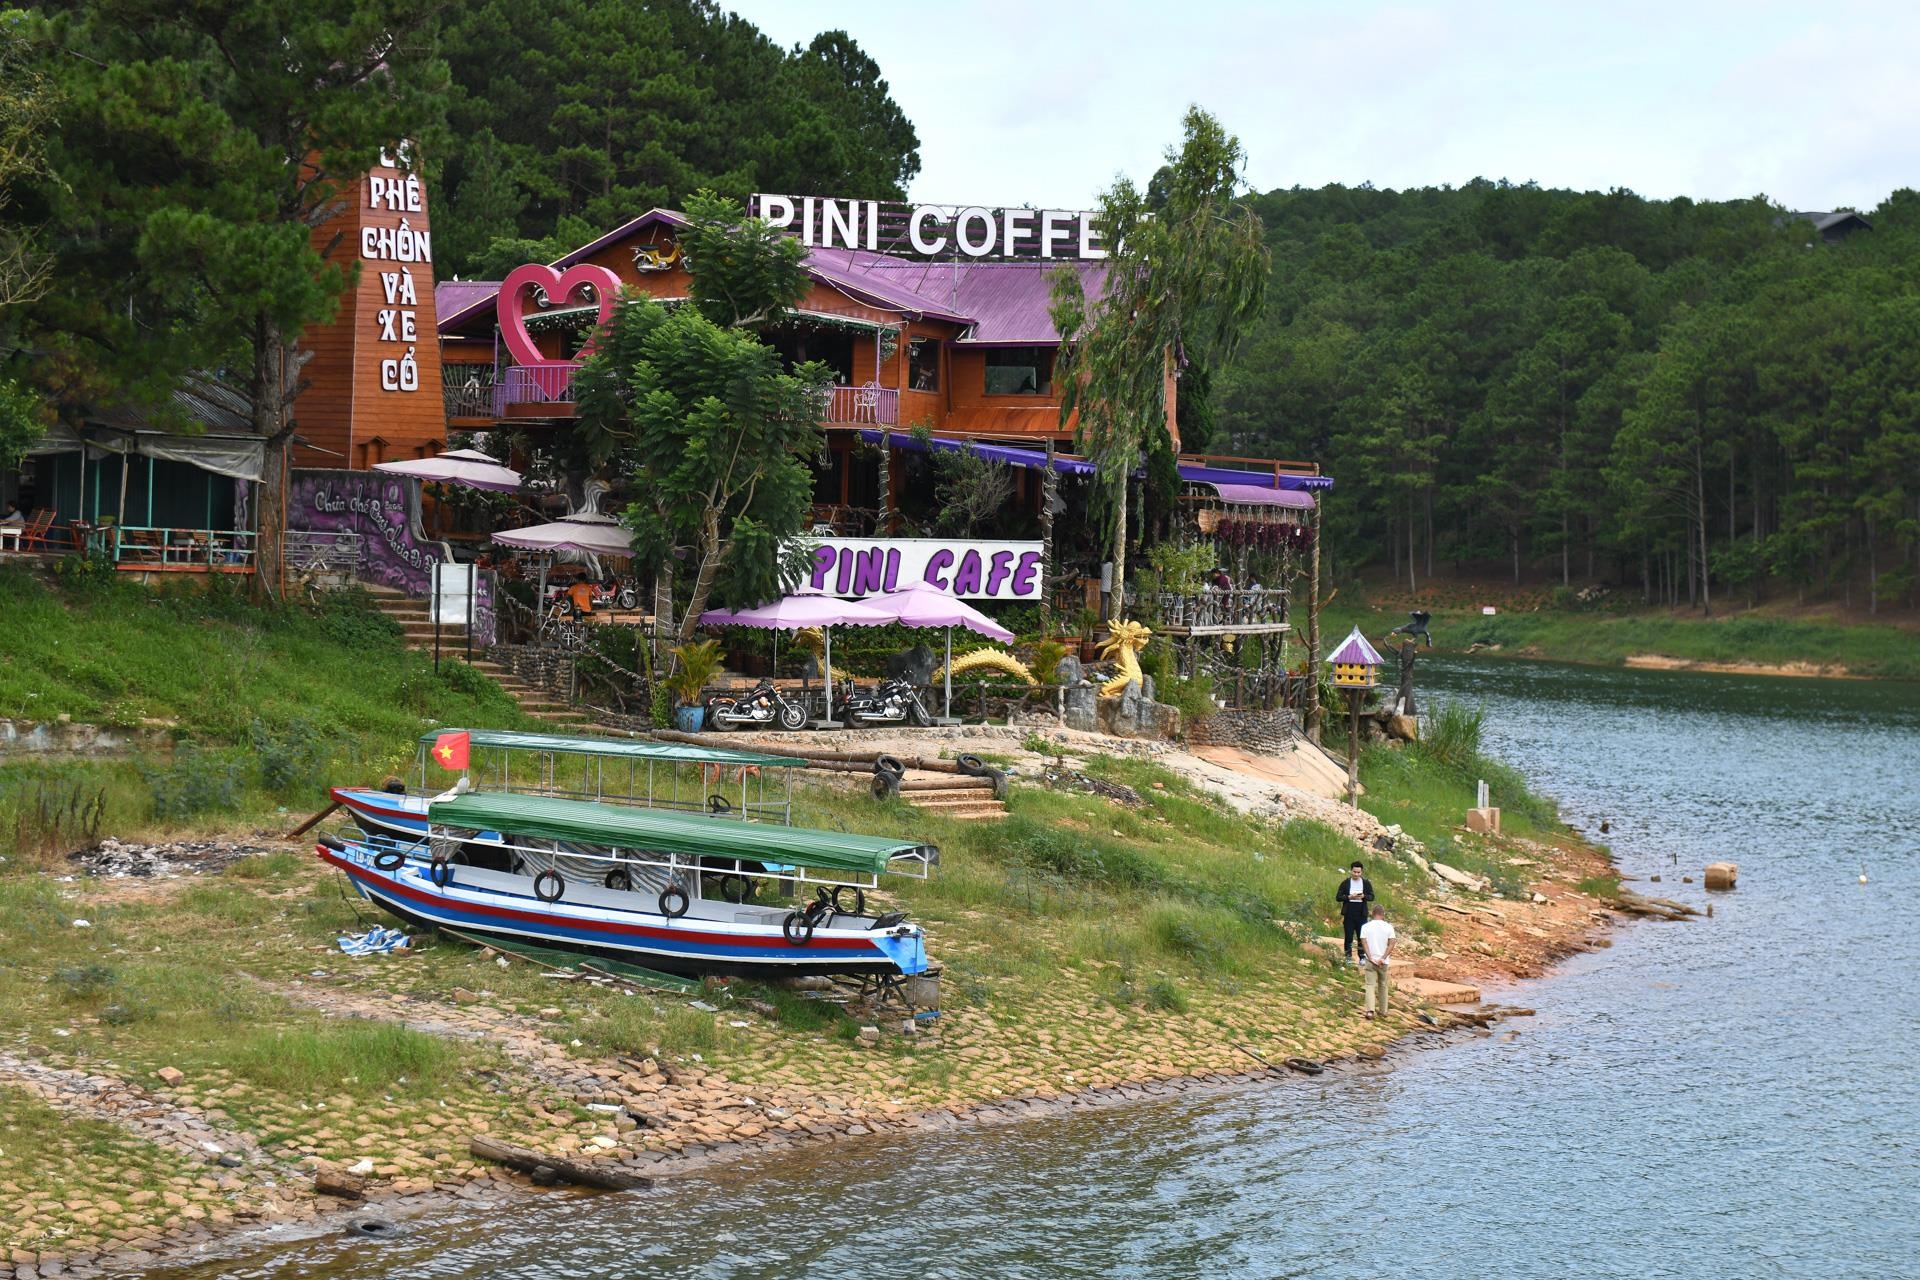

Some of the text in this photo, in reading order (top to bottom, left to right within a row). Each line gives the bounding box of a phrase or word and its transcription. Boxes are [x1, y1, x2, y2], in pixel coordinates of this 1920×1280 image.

[370, 174, 421, 212] PHÊ
[361, 218, 431, 263] CHỒN
[759, 195, 878, 251] PINI
[380, 266, 417, 305] VÀ
[378, 310, 417, 342] XE
[381, 346, 418, 391] CỔ
[811, 545, 901, 596] PINI
